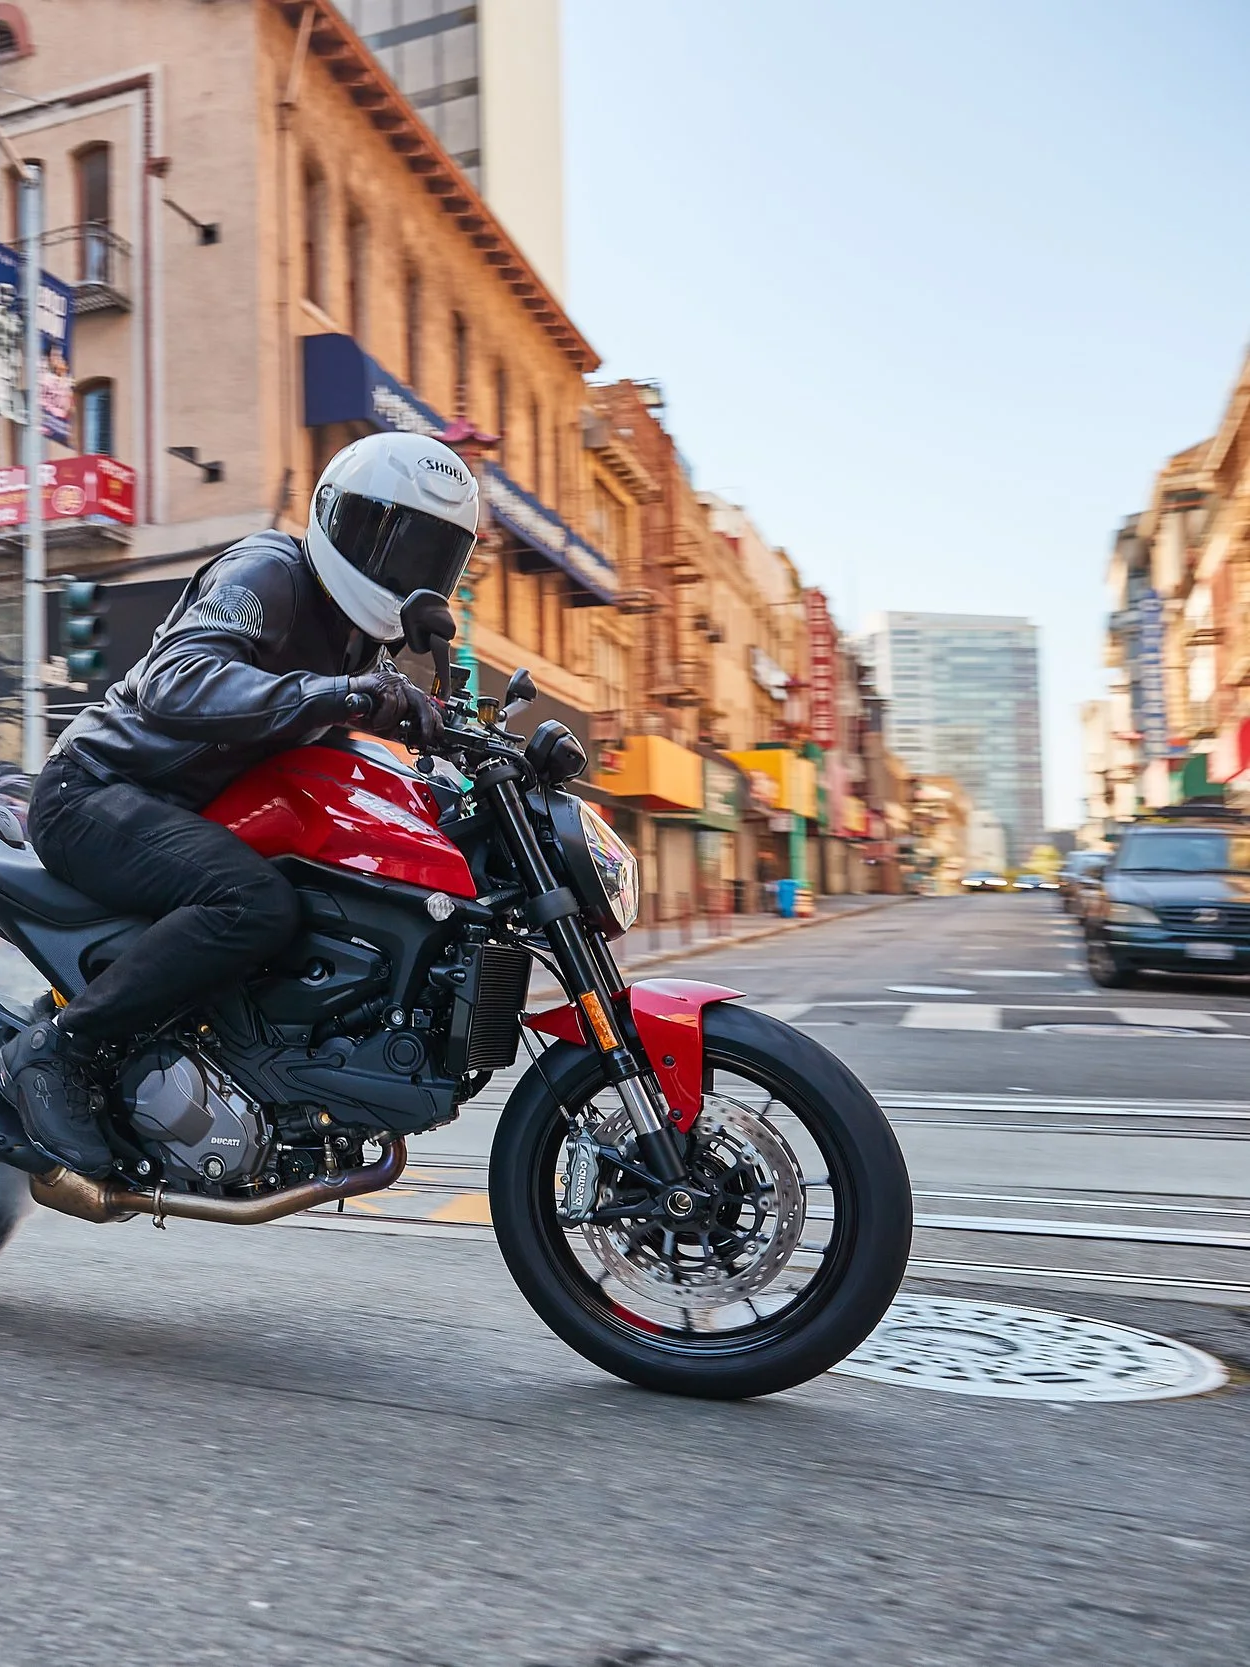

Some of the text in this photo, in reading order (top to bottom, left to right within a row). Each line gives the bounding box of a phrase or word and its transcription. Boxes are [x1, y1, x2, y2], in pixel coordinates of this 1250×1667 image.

[426, 459, 463, 482] SHOEI
[357, 796, 421, 833] DUCATI
[210, 1137, 240, 1147] DUCATI
[573, 1160, 588, 1206] brembo
